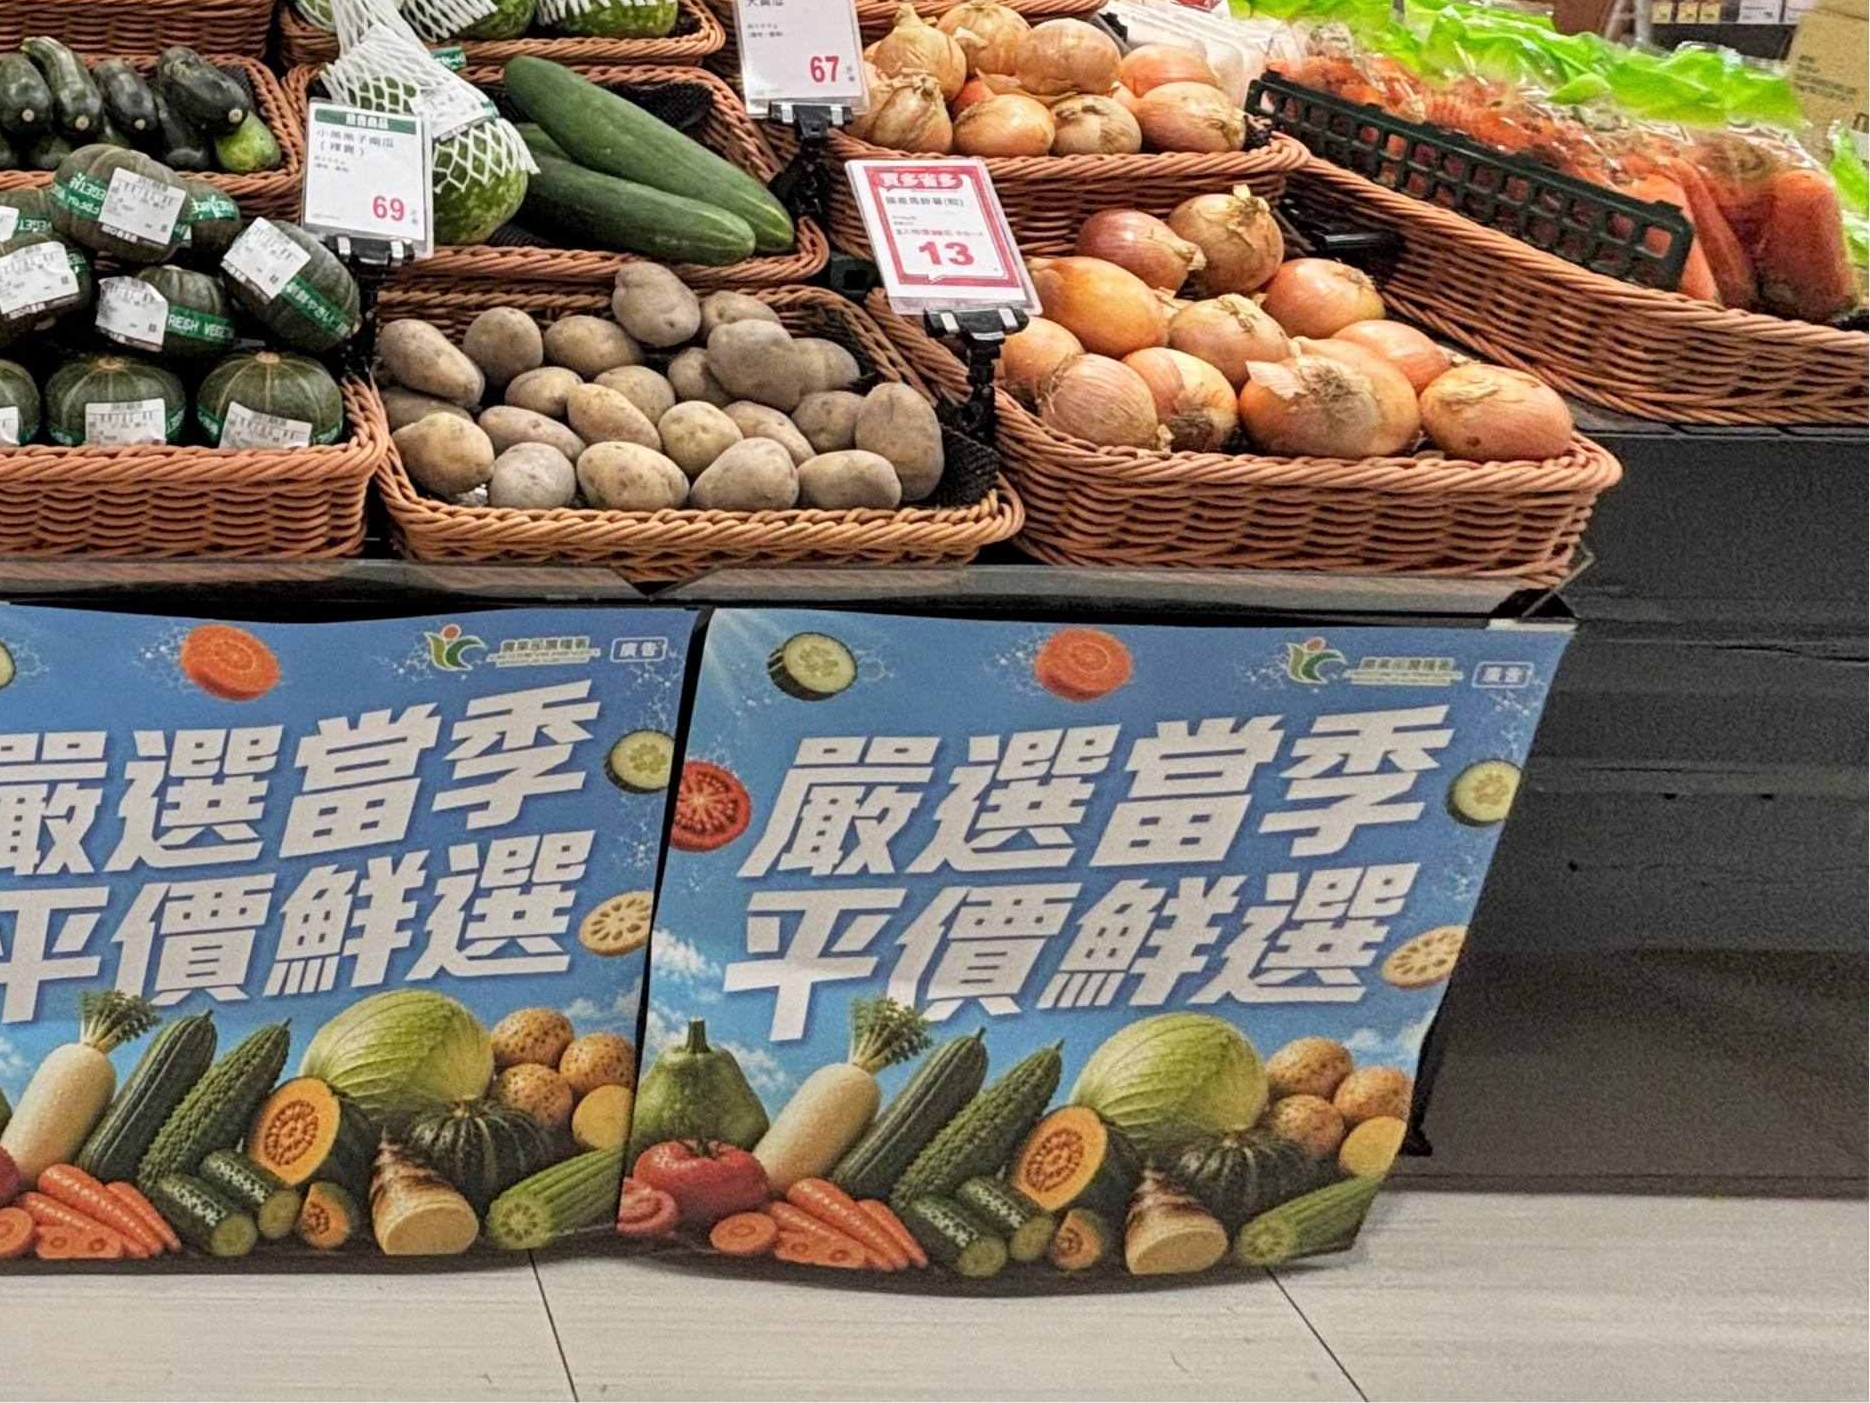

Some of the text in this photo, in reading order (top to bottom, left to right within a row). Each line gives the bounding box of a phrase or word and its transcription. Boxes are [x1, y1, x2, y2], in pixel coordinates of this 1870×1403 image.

[809, 54, 841, 83] 67
[372, 195, 406, 222] 69
[917, 240, 975, 267] 13
[738, 702, 1457, 879] 嚴選當季
[723, 861, 1421, 1043] 平價鮮選
